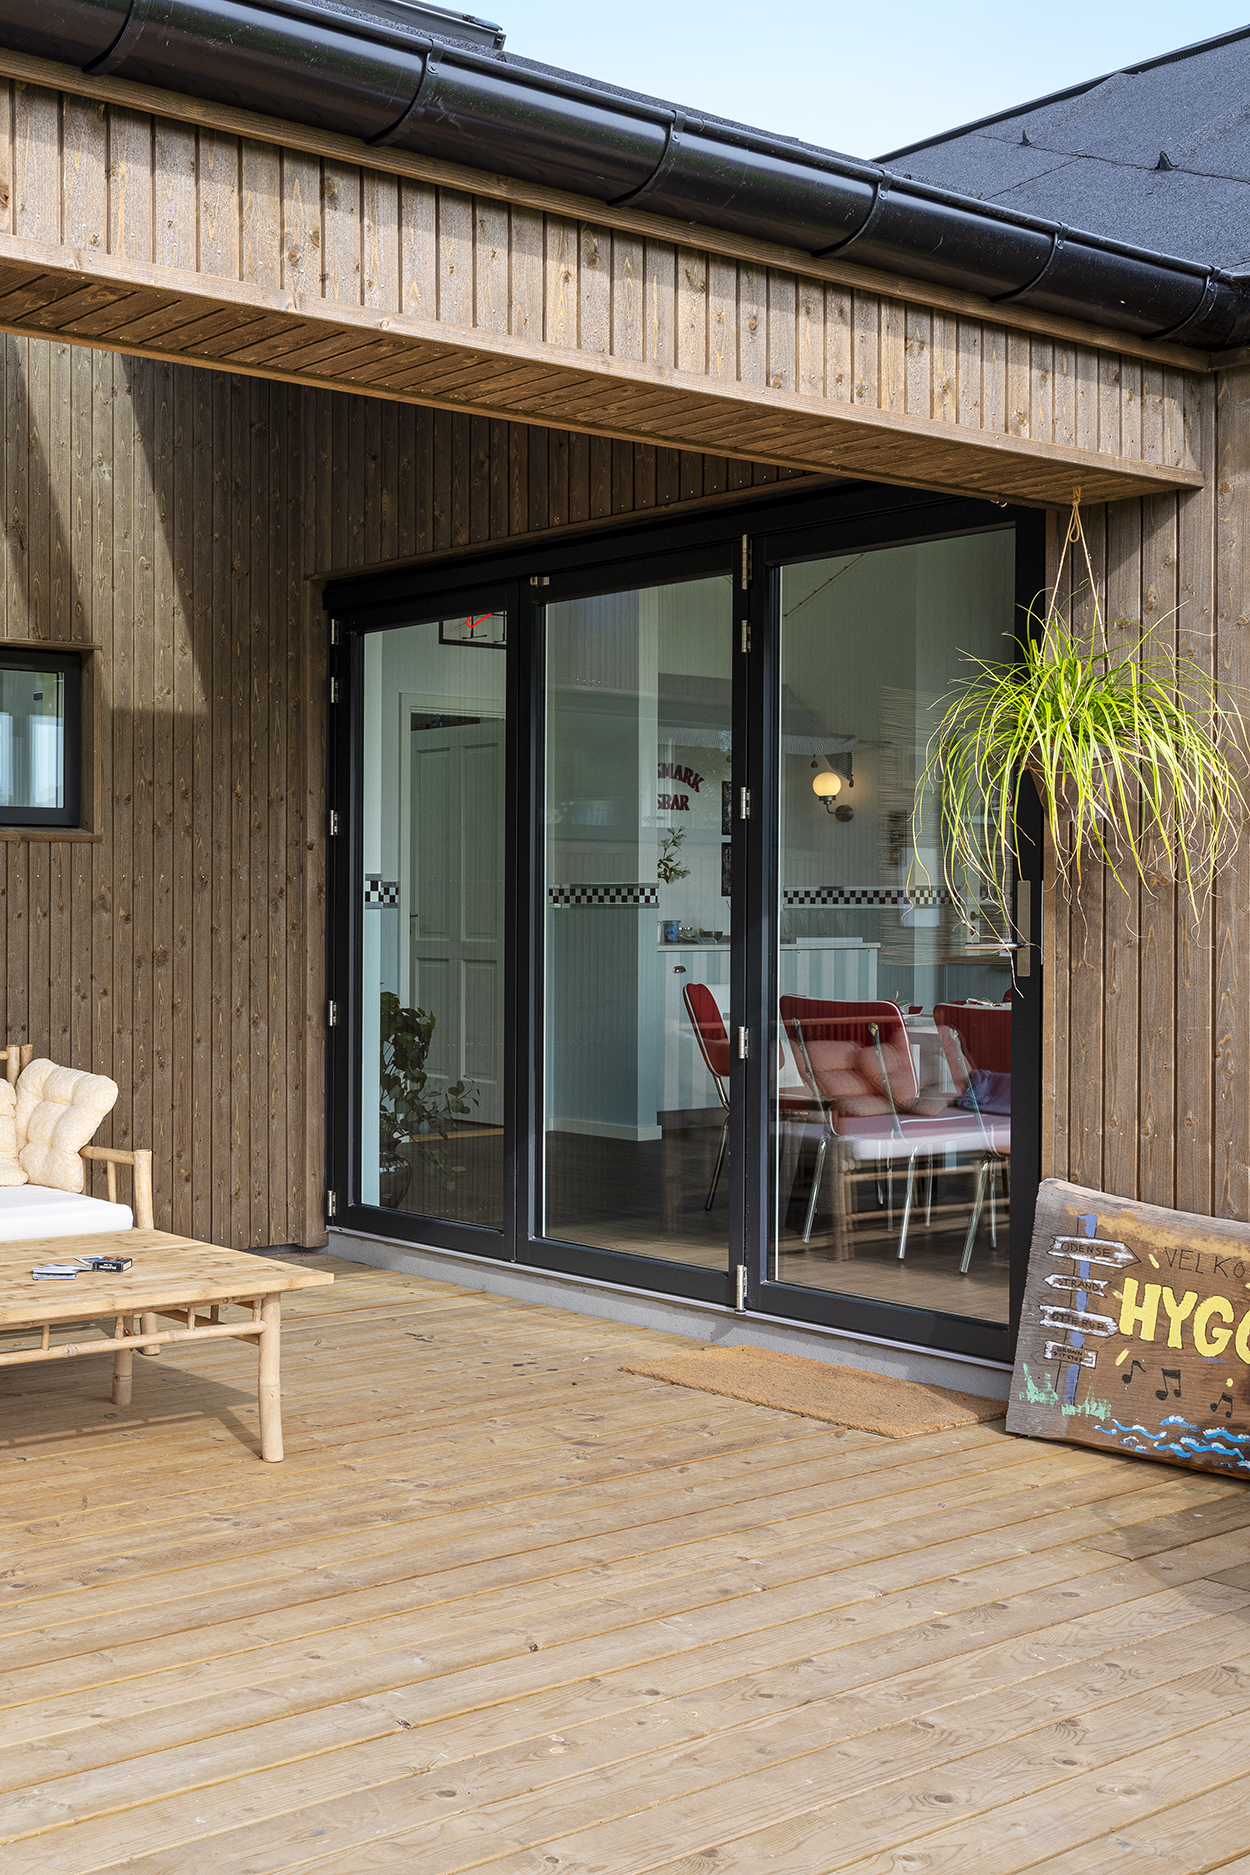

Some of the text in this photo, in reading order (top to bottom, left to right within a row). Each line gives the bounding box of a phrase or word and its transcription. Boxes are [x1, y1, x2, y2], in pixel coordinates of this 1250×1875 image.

[1060, 1241, 1111, 1258] ODENSE
[1058, 1278, 1100, 1292] STRAND
[1051, 1311, 1105, 1329] OTTERUP
